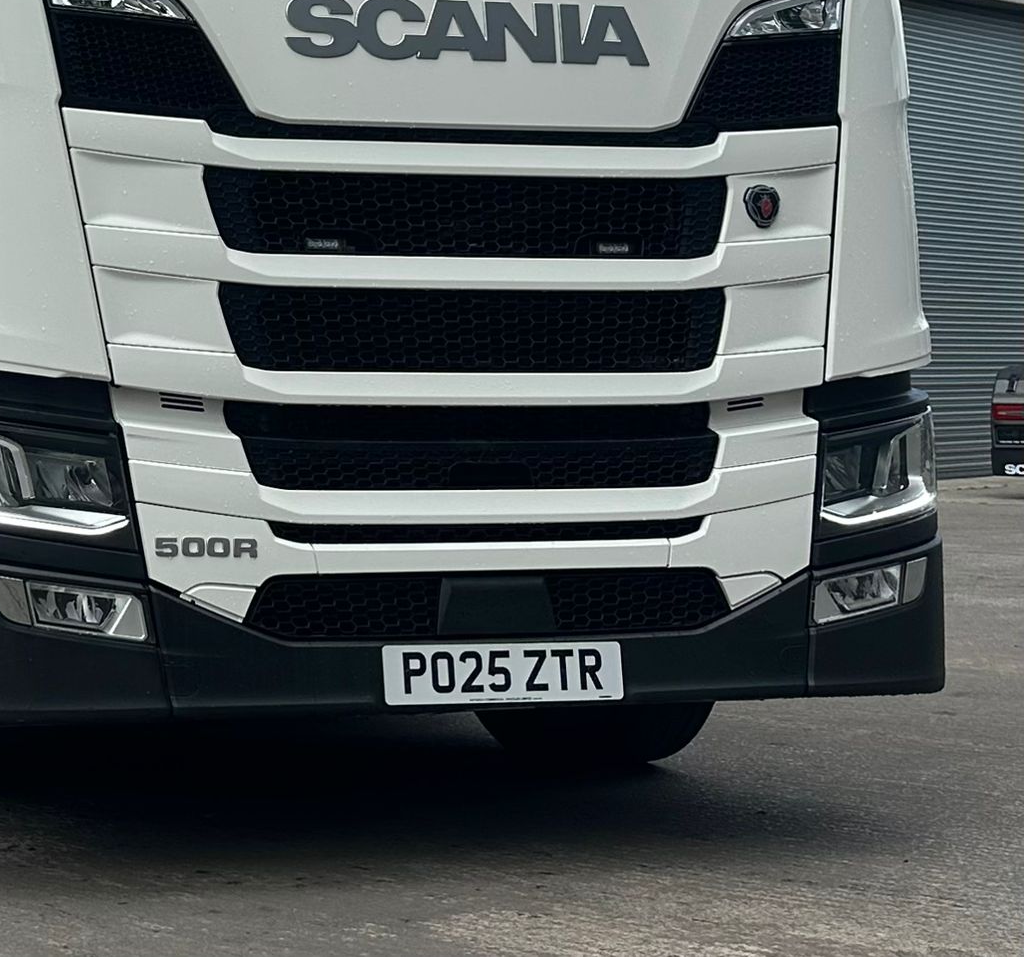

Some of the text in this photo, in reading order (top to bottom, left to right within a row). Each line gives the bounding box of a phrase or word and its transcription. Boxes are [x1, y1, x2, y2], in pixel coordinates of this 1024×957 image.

[155, 537, 258, 558] 500R
[402, 648, 604, 695] PO25 ZTR
